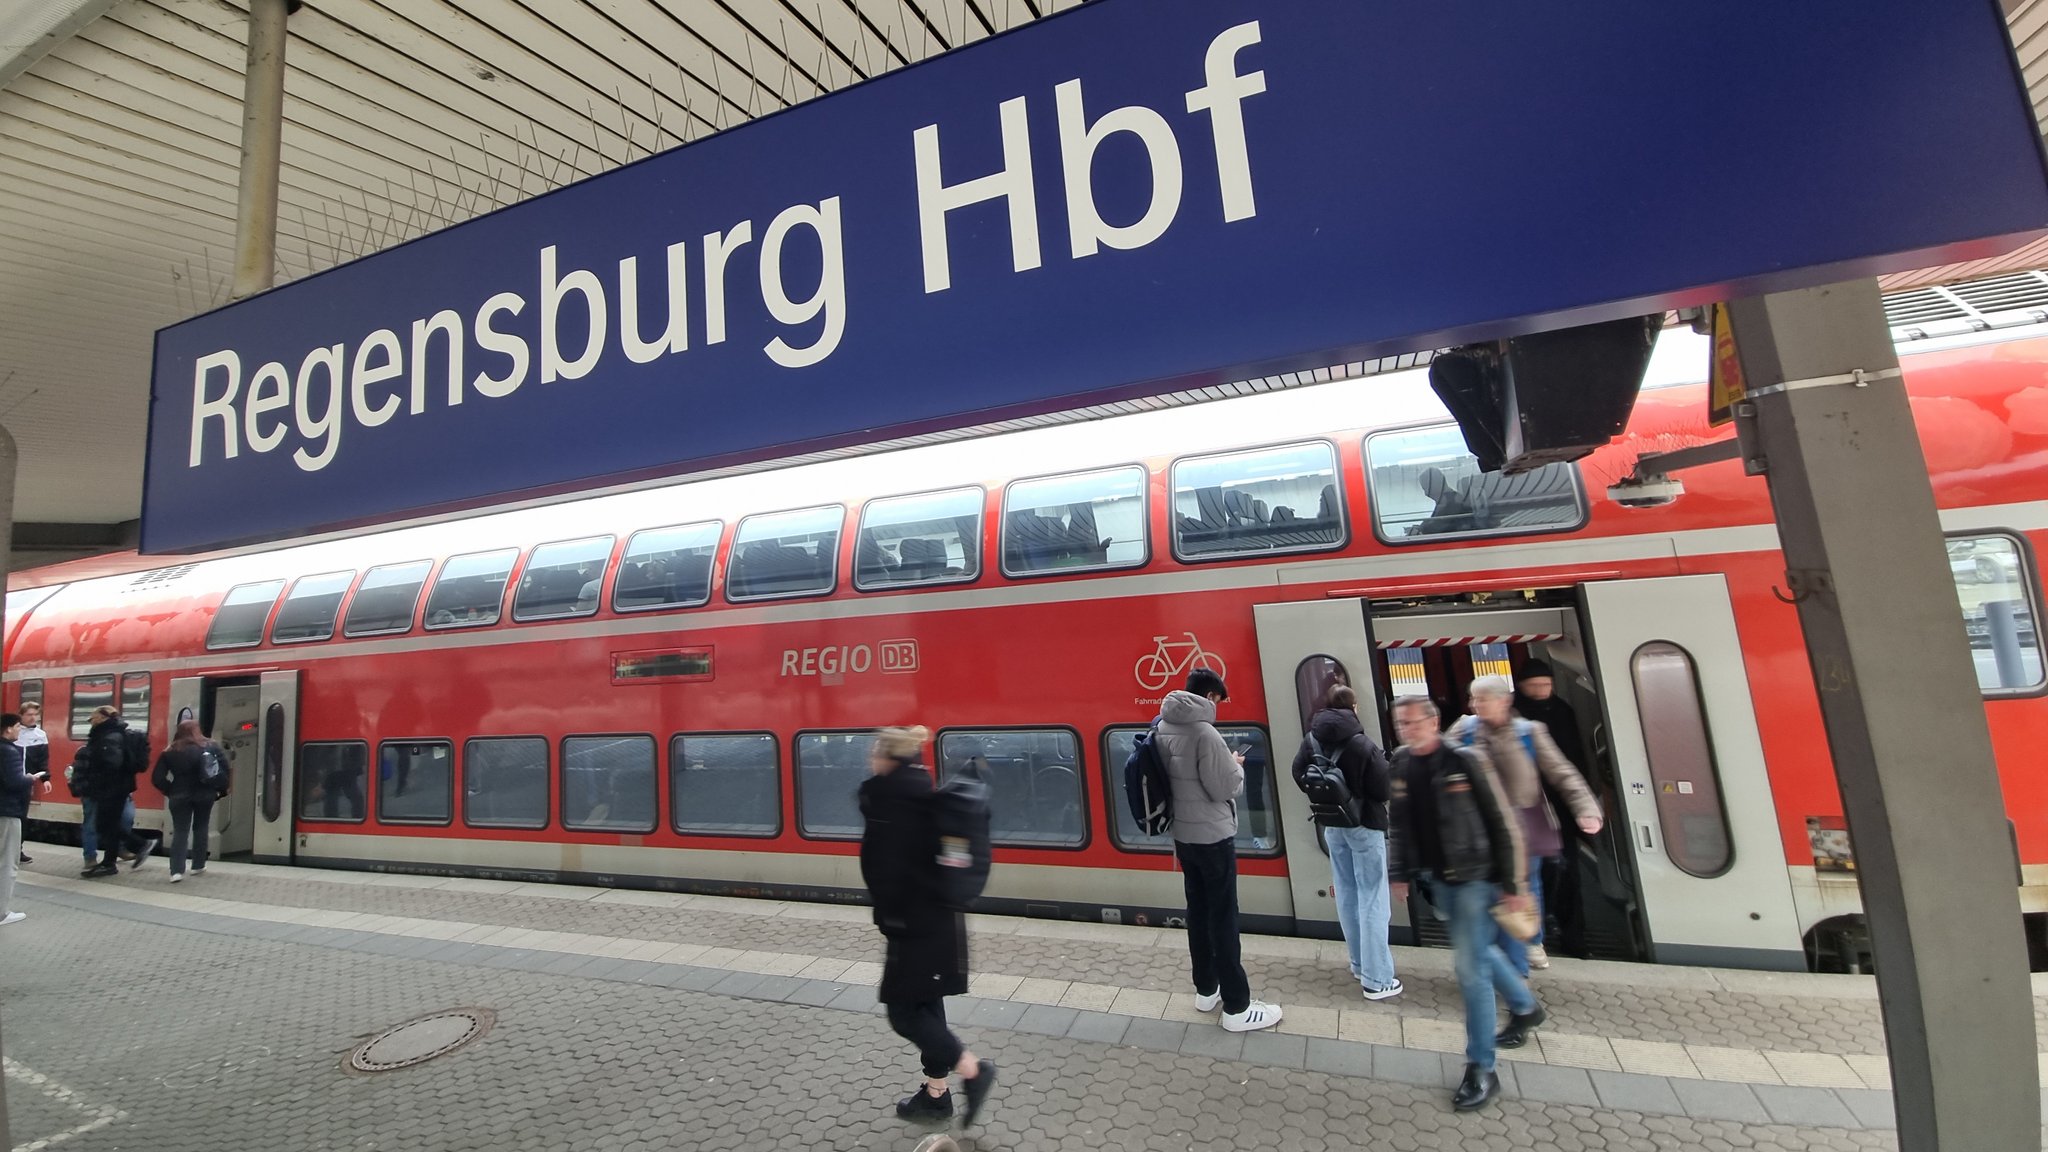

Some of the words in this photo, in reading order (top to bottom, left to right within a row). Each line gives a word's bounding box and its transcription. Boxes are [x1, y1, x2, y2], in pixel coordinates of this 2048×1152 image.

[189, 196, 846, 472] Regensburg
[913, 20, 1267, 293] Hbf
[781, 645, 872, 676] REGIO
[882, 642, 916, 669] DB
